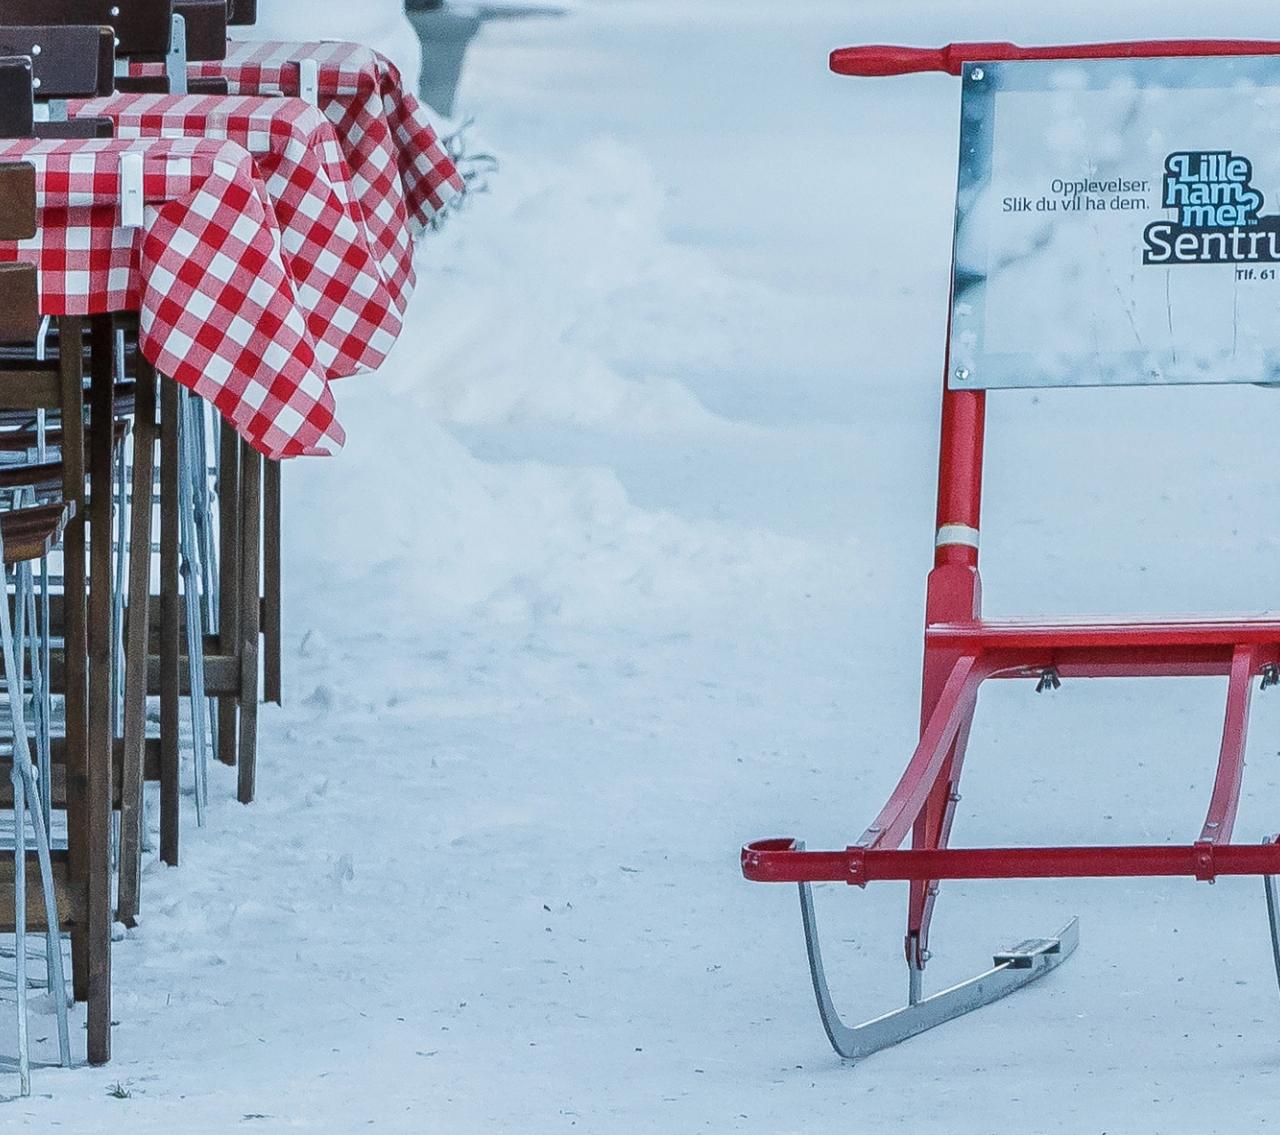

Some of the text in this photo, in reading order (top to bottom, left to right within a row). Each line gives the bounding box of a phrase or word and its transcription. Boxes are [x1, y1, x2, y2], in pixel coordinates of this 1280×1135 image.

[1169, 154, 1249, 182] Lille
[1051, 177, 1151, 197] Opplevelser.
[1166, 177, 1250, 205] ham
[1002, 196, 1150, 212] Slik du vil ha dem.
[1182, 203, 1250, 228] mer
[1236, 269, 1256, 280] Tlf.
[1260, 269, 1275, 280] 61
